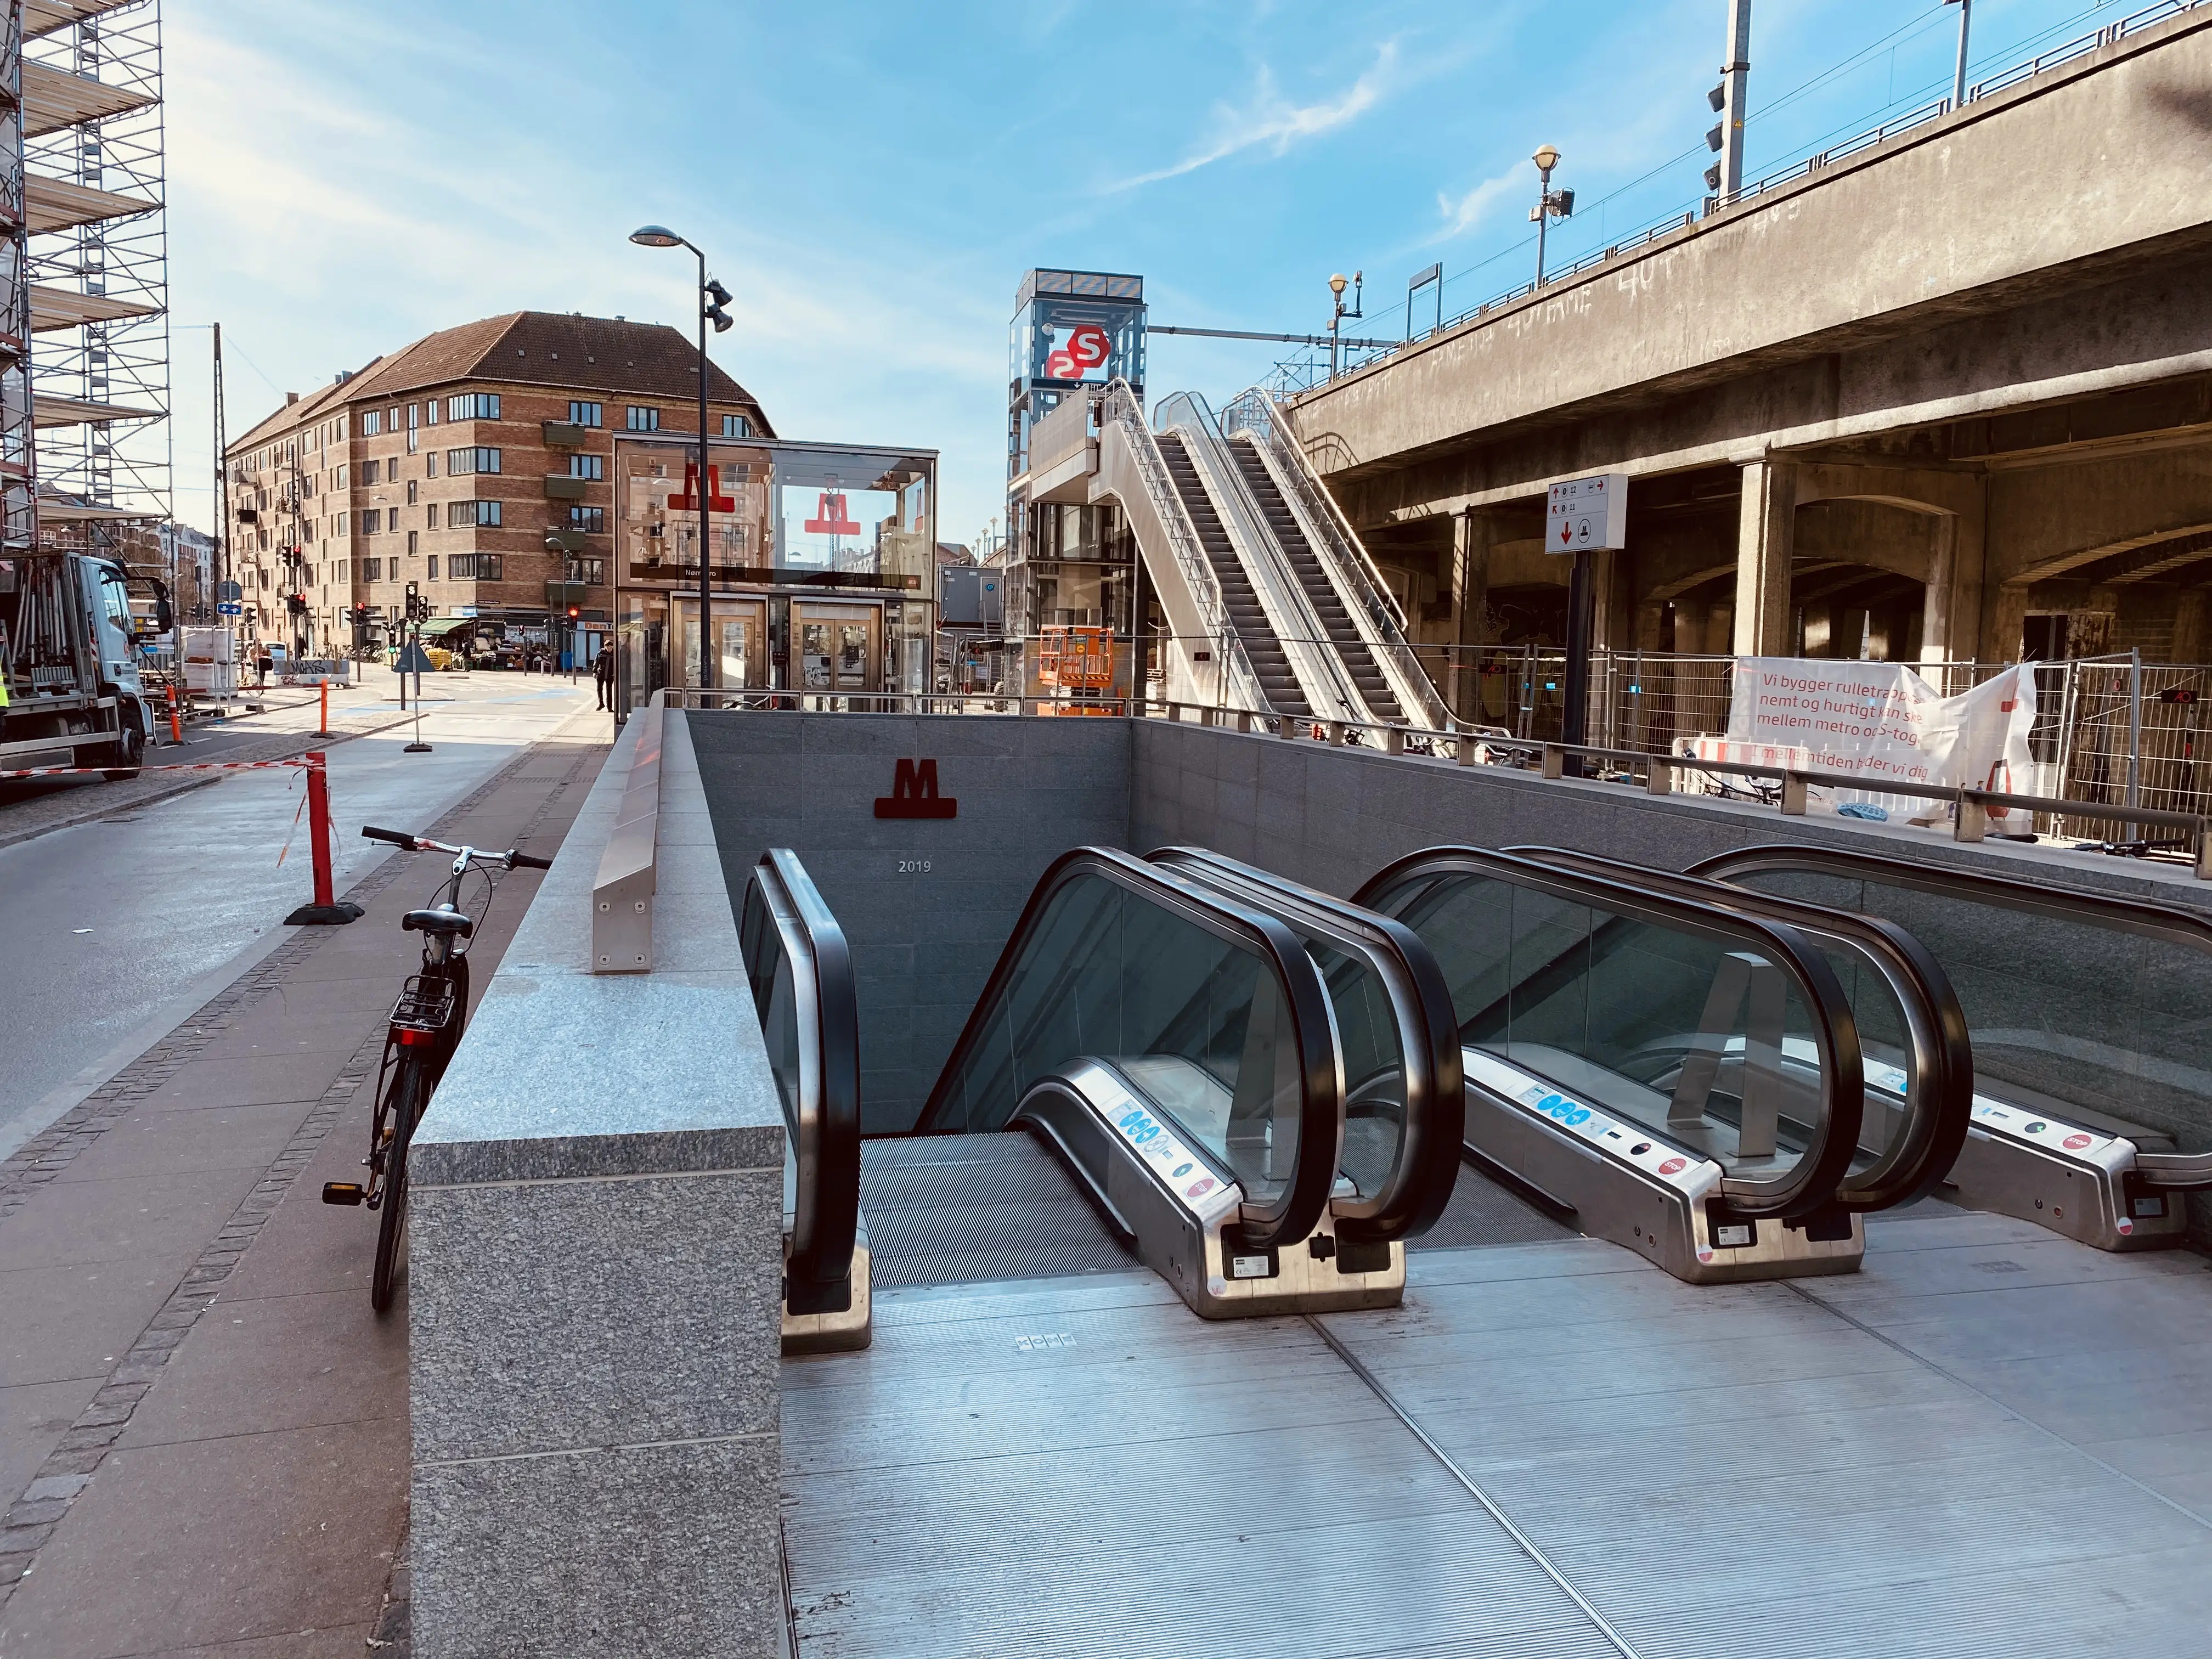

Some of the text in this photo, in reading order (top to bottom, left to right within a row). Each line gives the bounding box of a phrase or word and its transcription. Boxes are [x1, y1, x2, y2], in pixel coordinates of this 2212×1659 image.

[1077, 333, 1101, 360] S
[1570, 486, 1577, 494] 12
[1764, 673, 1778, 686] Vi
[1781, 675, 1834, 693] bygger
[2173, 692, 2191, 703] AO
[1760, 695, 1923, 725] nemt og hurtigt kan ske
[1757, 714, 1811, 728] mellem
[1815, 720, 1859, 735] metro
[1762, 748, 1854, 769] mellemtiden
[1893, 763, 1906, 775] vi
[1909, 765, 1928, 781] dig
[899, 861, 932, 872] 2019
[2067, 1137, 2088, 1146] STOP
[1664, 1161, 1681, 1170] STOP
[1195, 1182, 1207, 1193] STOP
